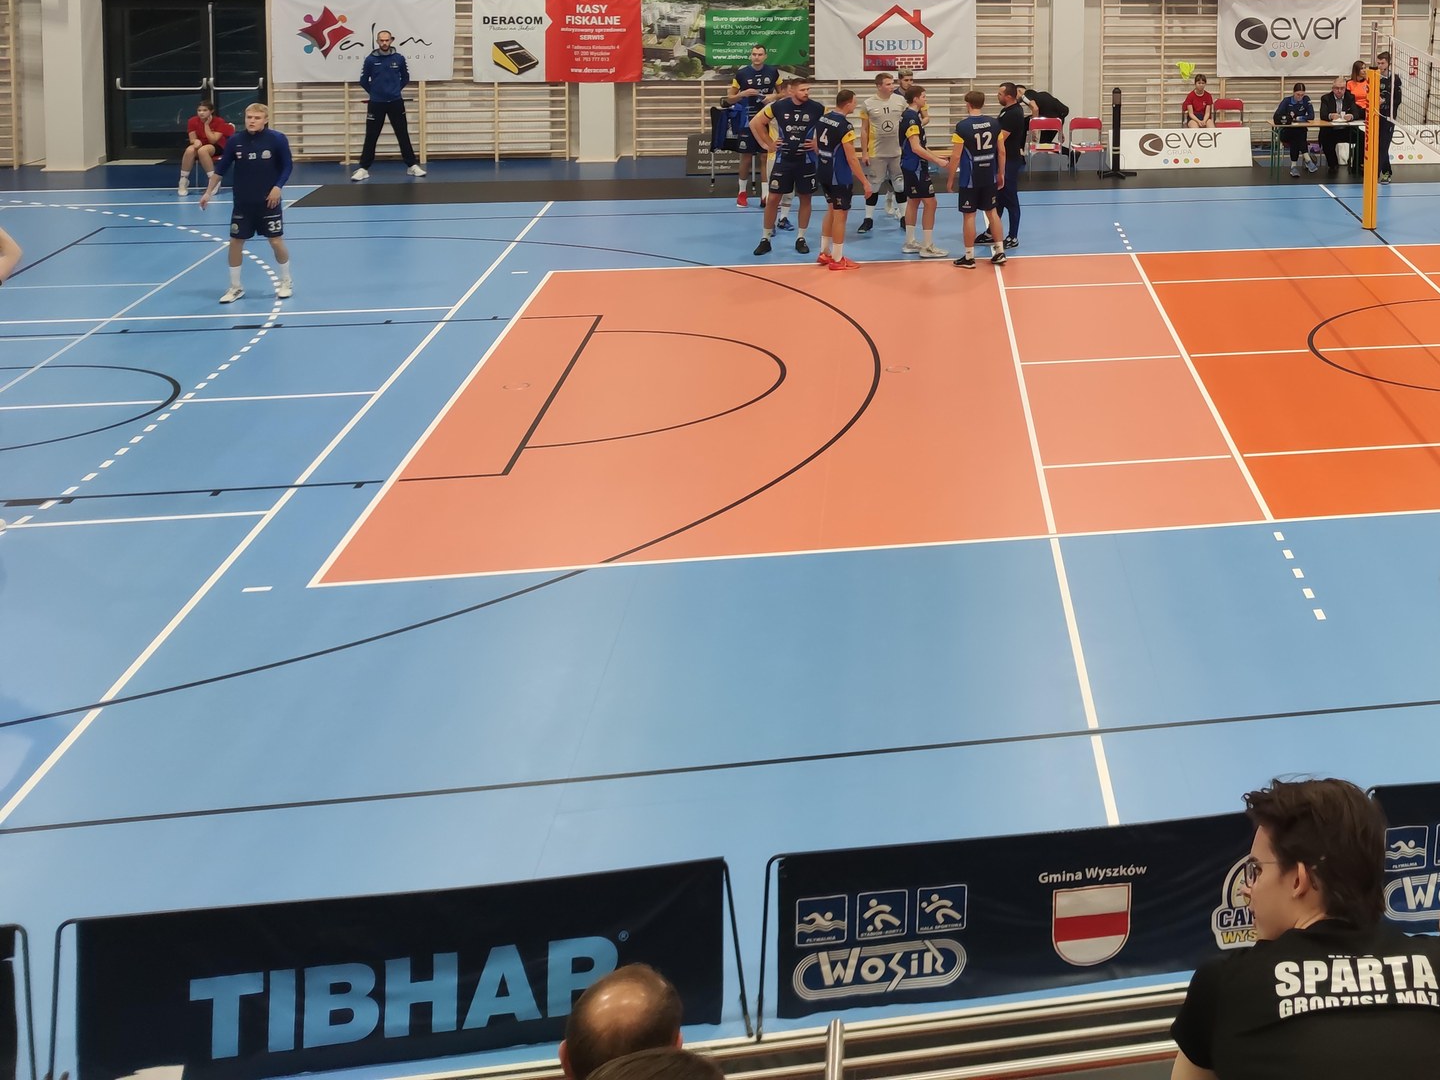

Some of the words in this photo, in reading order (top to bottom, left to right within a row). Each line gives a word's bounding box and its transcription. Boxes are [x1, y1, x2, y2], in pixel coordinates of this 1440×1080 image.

[576, 4, 608, 14] KASY
[482, 16, 543, 25] DERACOM
[565, 15, 621, 26] FISKALNE
[1270, 16, 1346, 40] ever
[868, 39, 924, 51] ISBUD
[1272, 42, 1306, 50] GRUPA
[756, 78, 762, 86] 2
[883, 106, 890, 114] 11
[794, 114, 800, 122] 9
[820, 128, 828, 146] 4
[974, 131, 993, 150] 12
[1165, 132, 1222, 149] ever
[248, 152, 257, 160] 33
[267, 220, 282, 232] 33
[1038, 870, 1083, 884] Gmina
[1085, 864, 1148, 881] Wyszków
